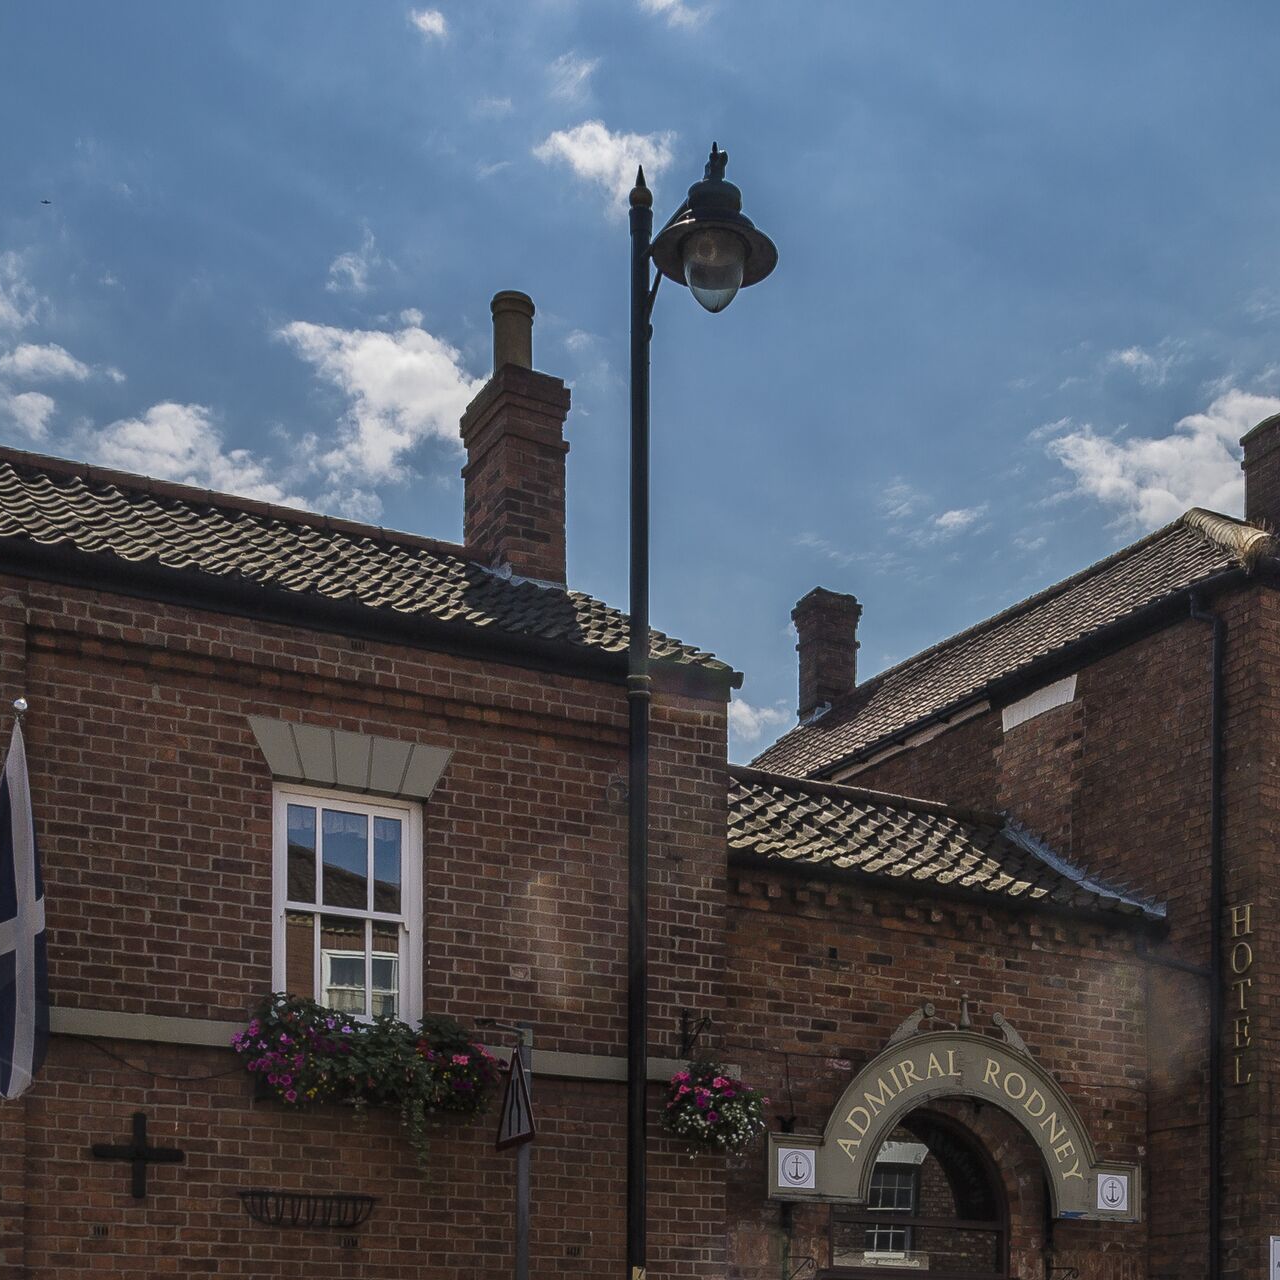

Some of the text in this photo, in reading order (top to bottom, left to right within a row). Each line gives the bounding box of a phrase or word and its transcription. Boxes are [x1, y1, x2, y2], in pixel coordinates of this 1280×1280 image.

[1230, 902, 1254, 1087] HOTEL
[836, 1050, 961, 1163] ADMIRAL
[982, 1058, 1084, 1181] RODNEY
